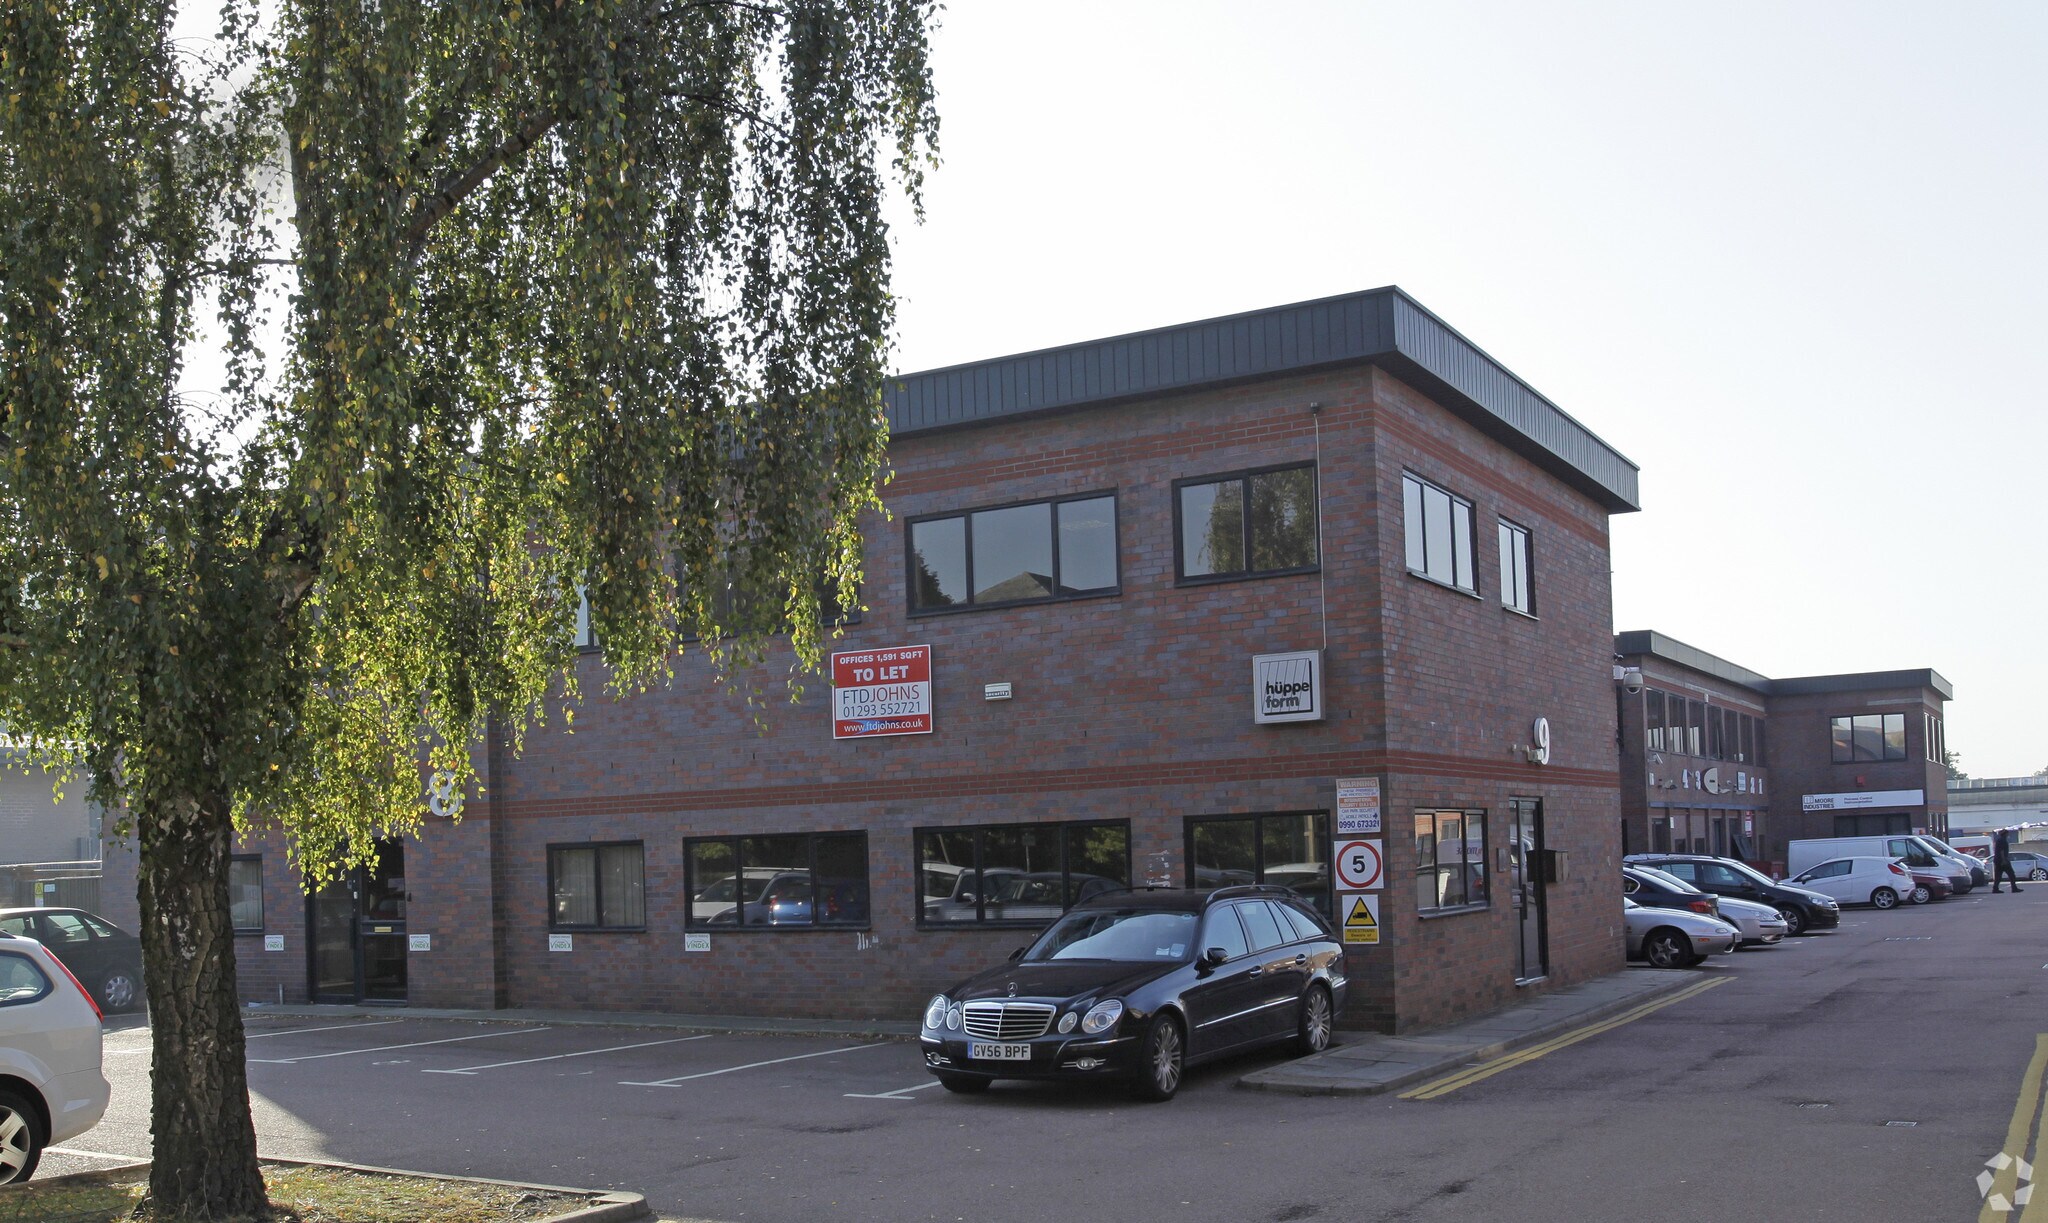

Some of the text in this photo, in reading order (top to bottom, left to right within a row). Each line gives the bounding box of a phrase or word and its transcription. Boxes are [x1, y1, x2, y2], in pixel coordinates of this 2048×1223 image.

[840, 654, 874, 664] OFFICES
[877, 653, 897, 662] 1,591
[853, 665, 909, 682] TO LET
[843, 684, 920, 704] FTDJOHNS
[1266, 680, 1309, 696] hüppe
[1266, 695, 1300, 708] form
[843, 702, 920, 718] 01293 552721
[844, 718, 923, 732] www.ftdjohns.co.uk
[1534, 717, 1550, 766] 9
[429, 770, 462, 816] 8
[1352, 855, 1365, 873] 5
[974, 1045, 1029, 1058] GV56 BPF
